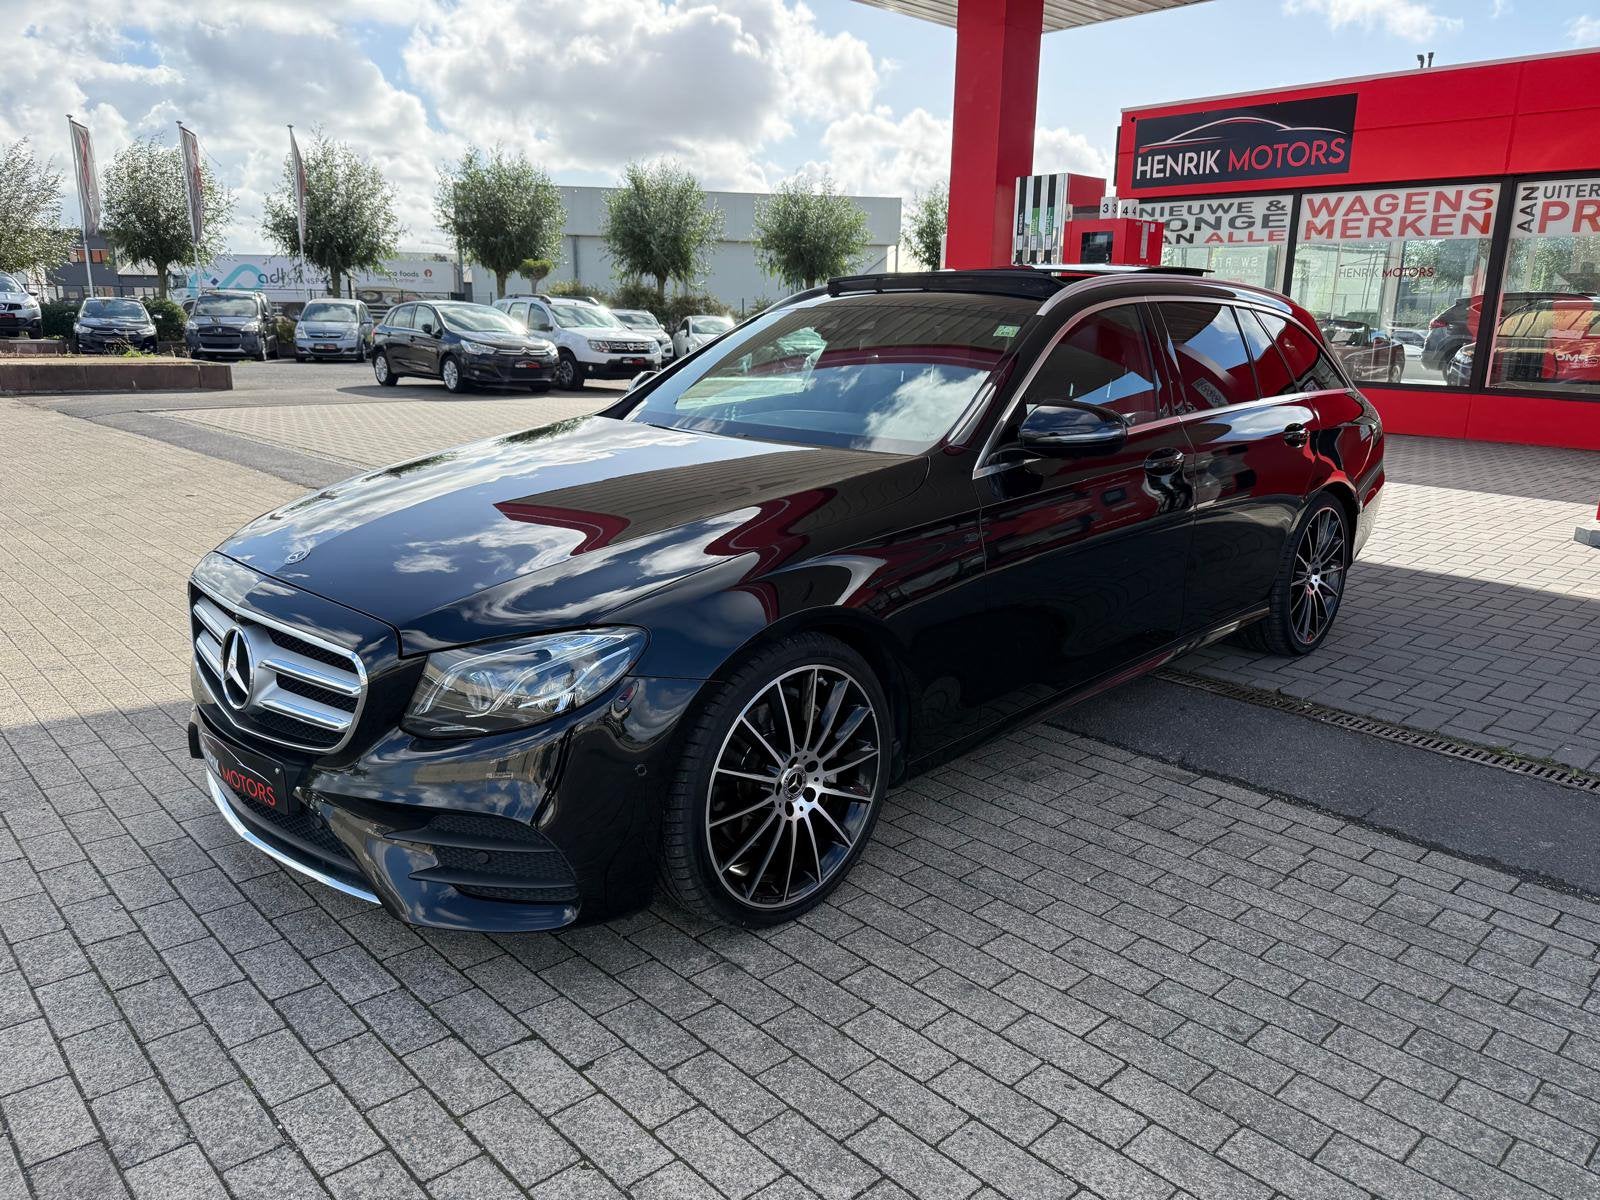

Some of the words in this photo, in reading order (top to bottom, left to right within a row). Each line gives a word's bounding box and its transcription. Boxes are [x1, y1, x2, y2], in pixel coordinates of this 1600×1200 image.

[1136, 150, 1221, 180] HENRIK
[1228, 138, 1346, 172] MOTORS
[1543, 184, 1600, 199] UITER
[1102, 204, 1109, 213] 3
[1112, 204, 1117, 213] 3
[1122, 206, 1129, 215] 4
[1132, 207, 1137, 215] 4
[1139, 201, 1254, 218] NIEUWE
[1266, 200, 1287, 212] &
[1306, 188, 1494, 218] WAGENS
[1517, 186, 1540, 233] AAN
[1154, 213, 1288, 232] ONGE
[1538, 199, 1600, 233] PR
[1304, 212, 1492, 240] MERKEN
[1162, 232, 1194, 244] AN
[1204, 230, 1286, 243] ALLE
[1339, 267, 1379, 278] HENRIK
[1382, 267, 1434, 278] MOTORS
[220, 762, 276, 807] MOTORS
